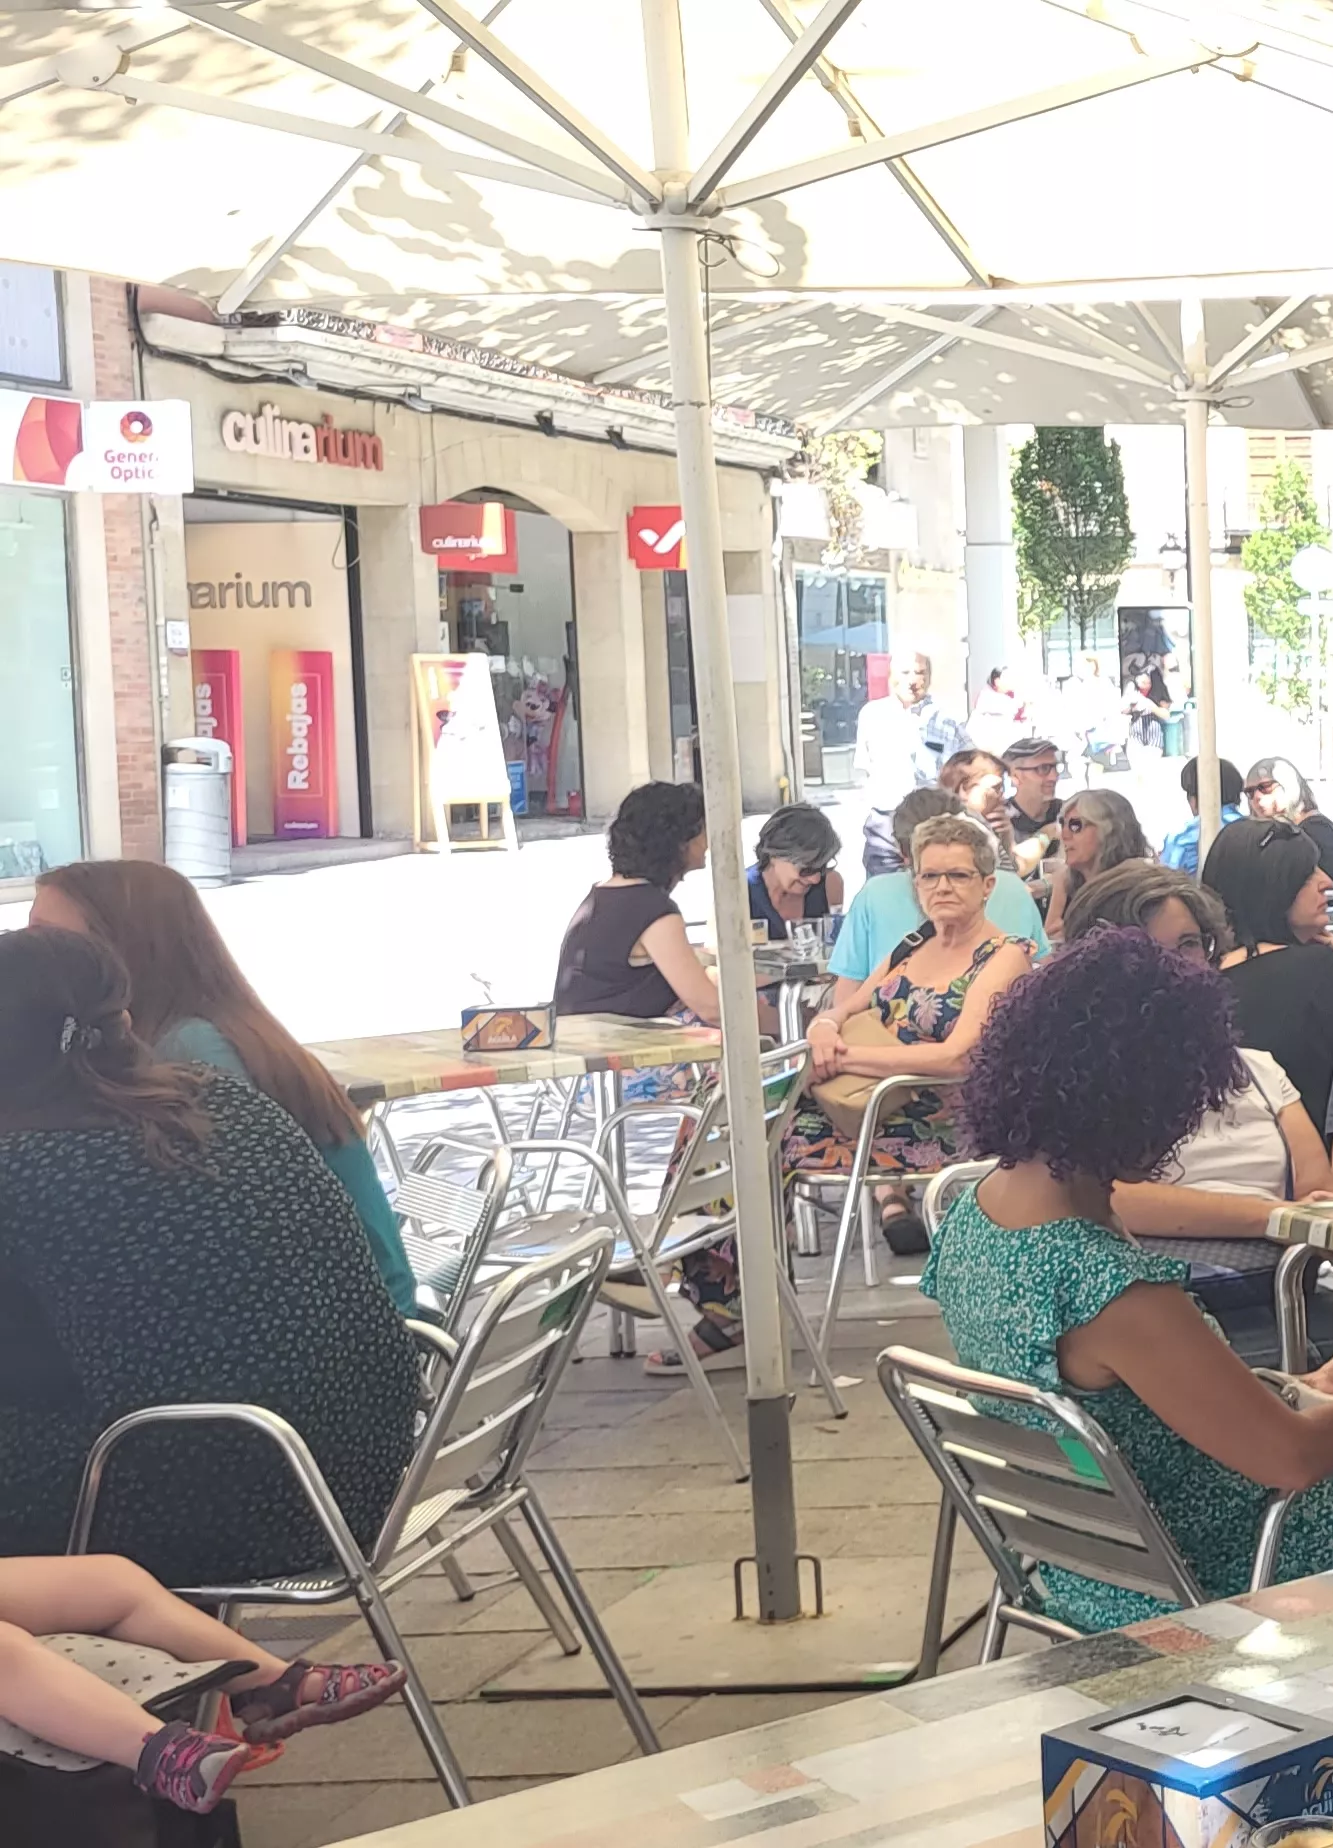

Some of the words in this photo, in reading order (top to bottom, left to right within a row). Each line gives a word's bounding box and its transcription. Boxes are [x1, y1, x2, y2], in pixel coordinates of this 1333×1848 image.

[222, 401, 384, 472] culinarium
[103, 448, 159, 464] Gener
[110, 465, 156, 482] Optic
[187, 572, 312, 609] arium
[286, 682, 313, 790] Rebajas
